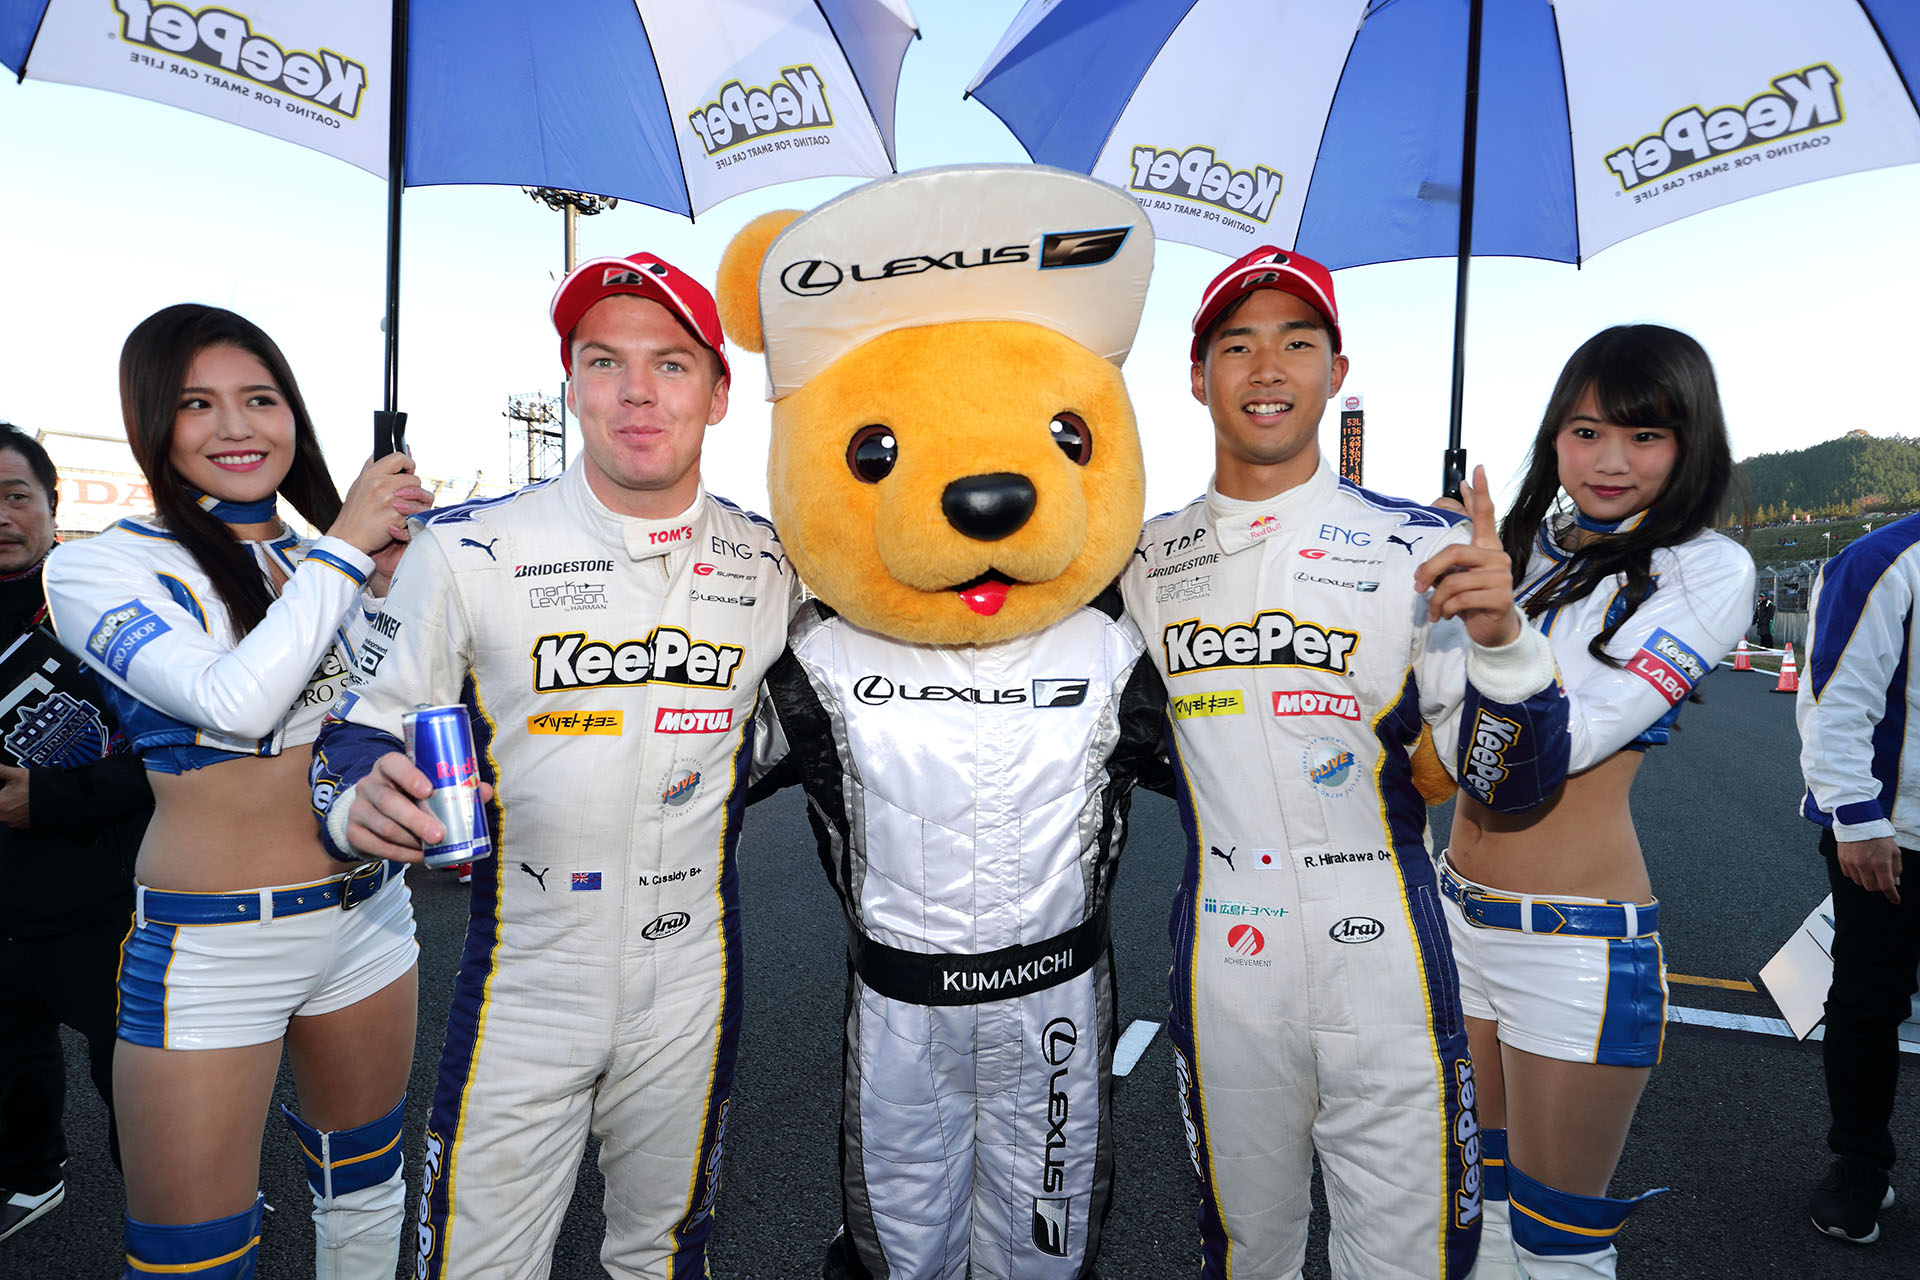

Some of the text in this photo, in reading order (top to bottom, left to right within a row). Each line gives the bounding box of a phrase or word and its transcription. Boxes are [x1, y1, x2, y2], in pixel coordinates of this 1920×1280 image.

[851, 245, 1030, 282] LEXUS
[649, 526, 693, 545] TOM'S
[1319, 524, 1371, 547] ENG
[712, 536, 752, 560] ENG
[514, 560, 614, 578] BRIDGESTONE
[1147, 553, 1221, 579] BRIDGESTONE
[1310, 576, 1355, 589] LEXUS
[701, 594, 738, 604] LEXUS
[123, 622, 156, 650] SHOP
[372, 610, 402, 641] NKEI
[1162, 608, 1361, 677] KeePer
[531, 625, 745, 694] KeePer
[1636, 658, 1685, 700] LABO
[900, 685, 1027, 704] LEXUS
[1277, 693, 1359, 717] MOTUL
[533, 713, 618, 732] マツモトキヨシ
[658, 711, 730, 732] MOTUL
[1319, 852, 1373, 865] Hirakawa
[1219, 904, 1289, 917] 広島トヨペット
[1335, 920, 1377, 937] Arai
[943, 948, 1073, 991] KUMAKICHI
[1224, 957, 1273, 967] ACHIEVEMENT
[1043, 1067, 1069, 1194] LEXUS
[1455, 1059, 1483, 1229] KeePer
